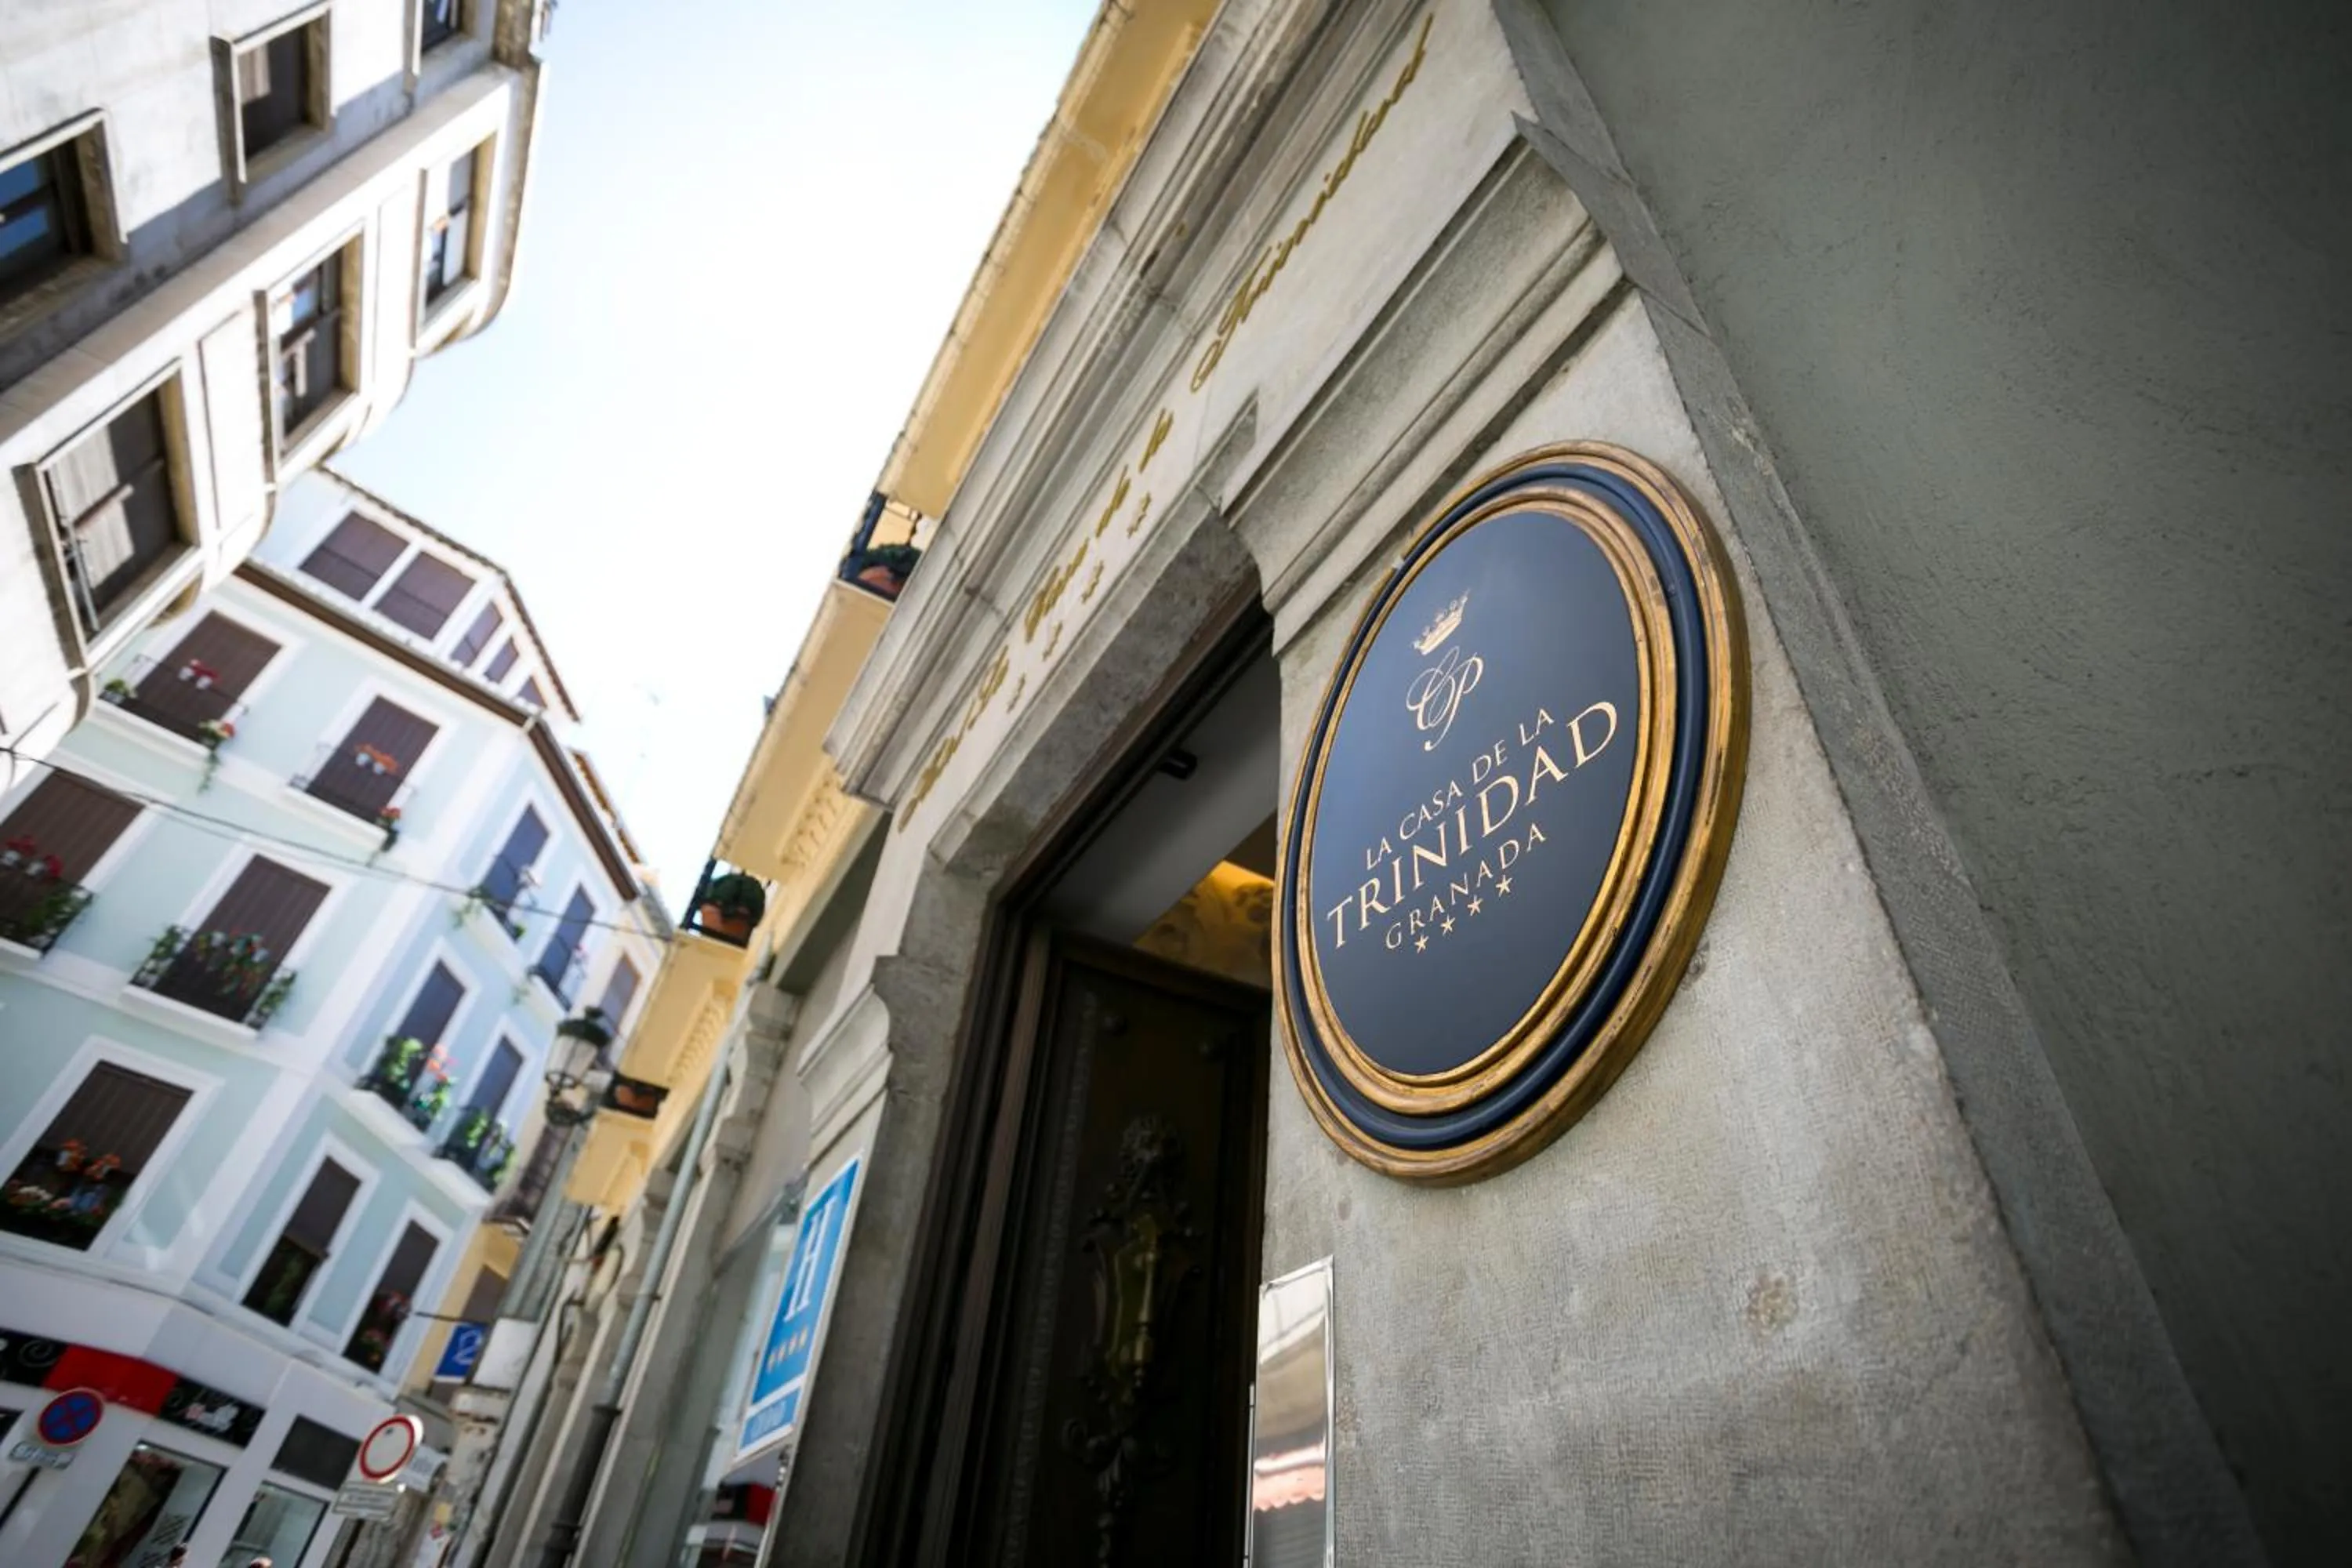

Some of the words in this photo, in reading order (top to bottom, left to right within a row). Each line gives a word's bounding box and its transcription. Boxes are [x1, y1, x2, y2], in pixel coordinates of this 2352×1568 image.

[1327, 702, 1617, 949] TRINIDAD
[1366, 836, 1392, 870] LA
[1399, 779, 1463, 840] CASA
[1472, 739, 1508, 784] DE
[1519, 708, 1555, 746] LA
[1385, 823, 1547, 949] GRANADA
